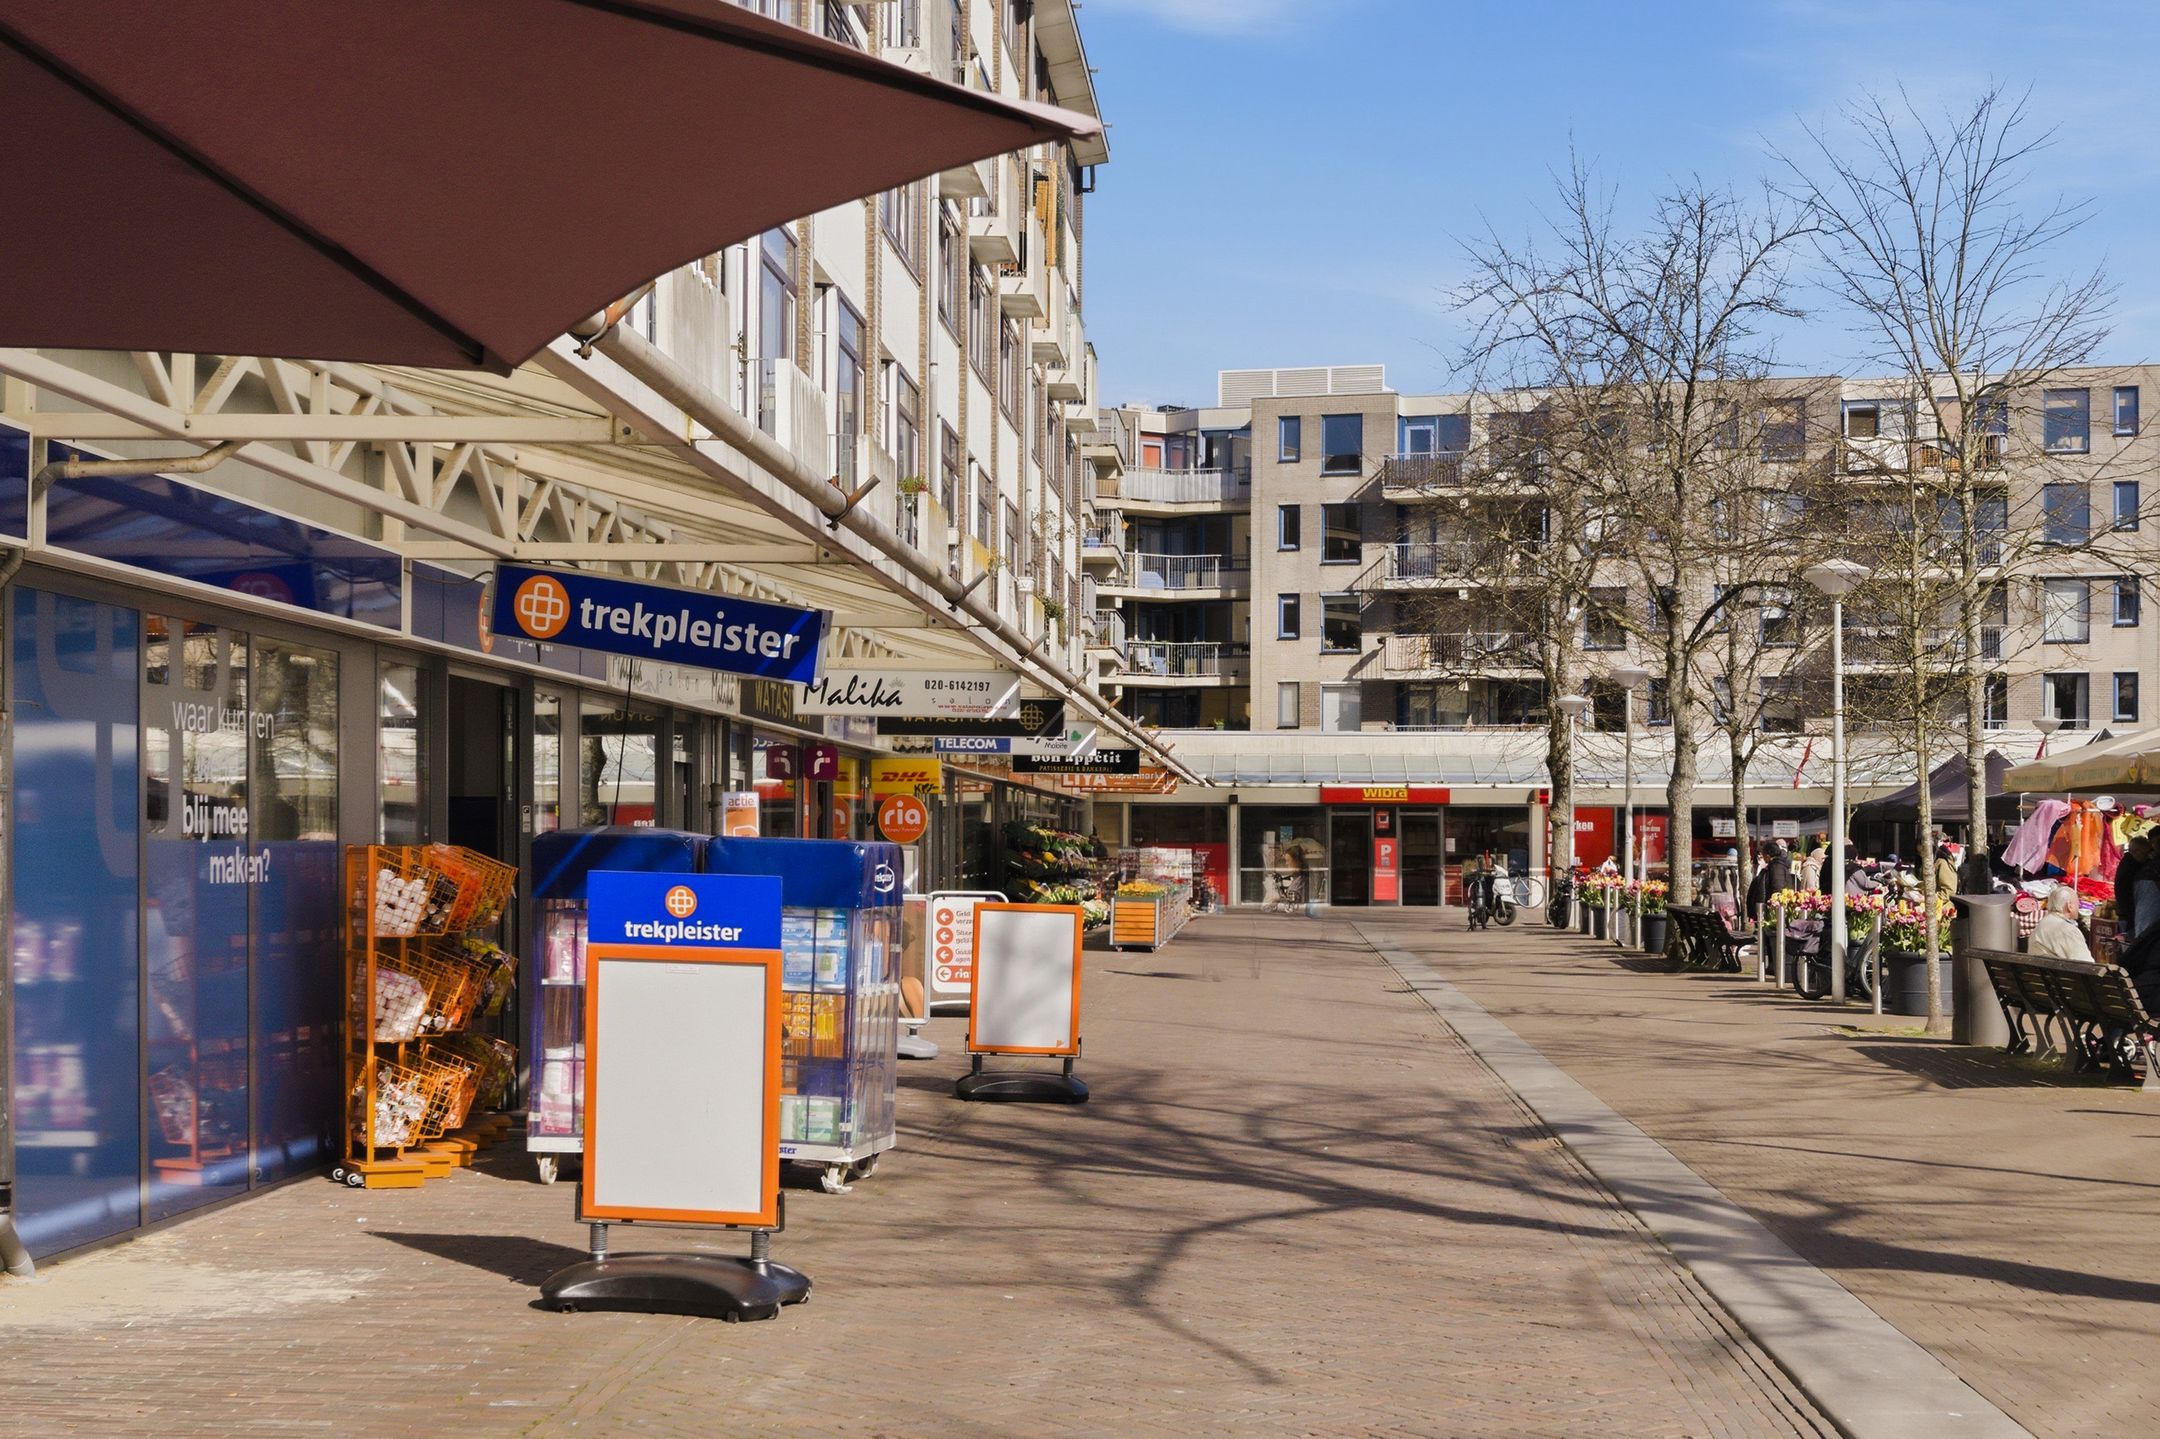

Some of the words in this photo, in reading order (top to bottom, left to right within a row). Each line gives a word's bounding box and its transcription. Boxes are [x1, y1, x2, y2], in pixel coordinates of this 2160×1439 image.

[580, 598, 800, 660] trekpleister
[803, 674, 903, 707] Malika
[925, 680, 990, 692] 020-6142197
[172, 701, 213, 732] waar
[938, 738, 998, 750] TELECOM
[881, 772, 929, 782] DHL
[728, 795, 755, 807] actie
[885, 800, 921, 825] ria
[182, 795, 209, 843] blij
[213, 806, 249, 834] mee
[209, 846, 270, 884] maken?
[624, 920, 743, 943] trekpleister
[954, 968, 970, 979] ria
